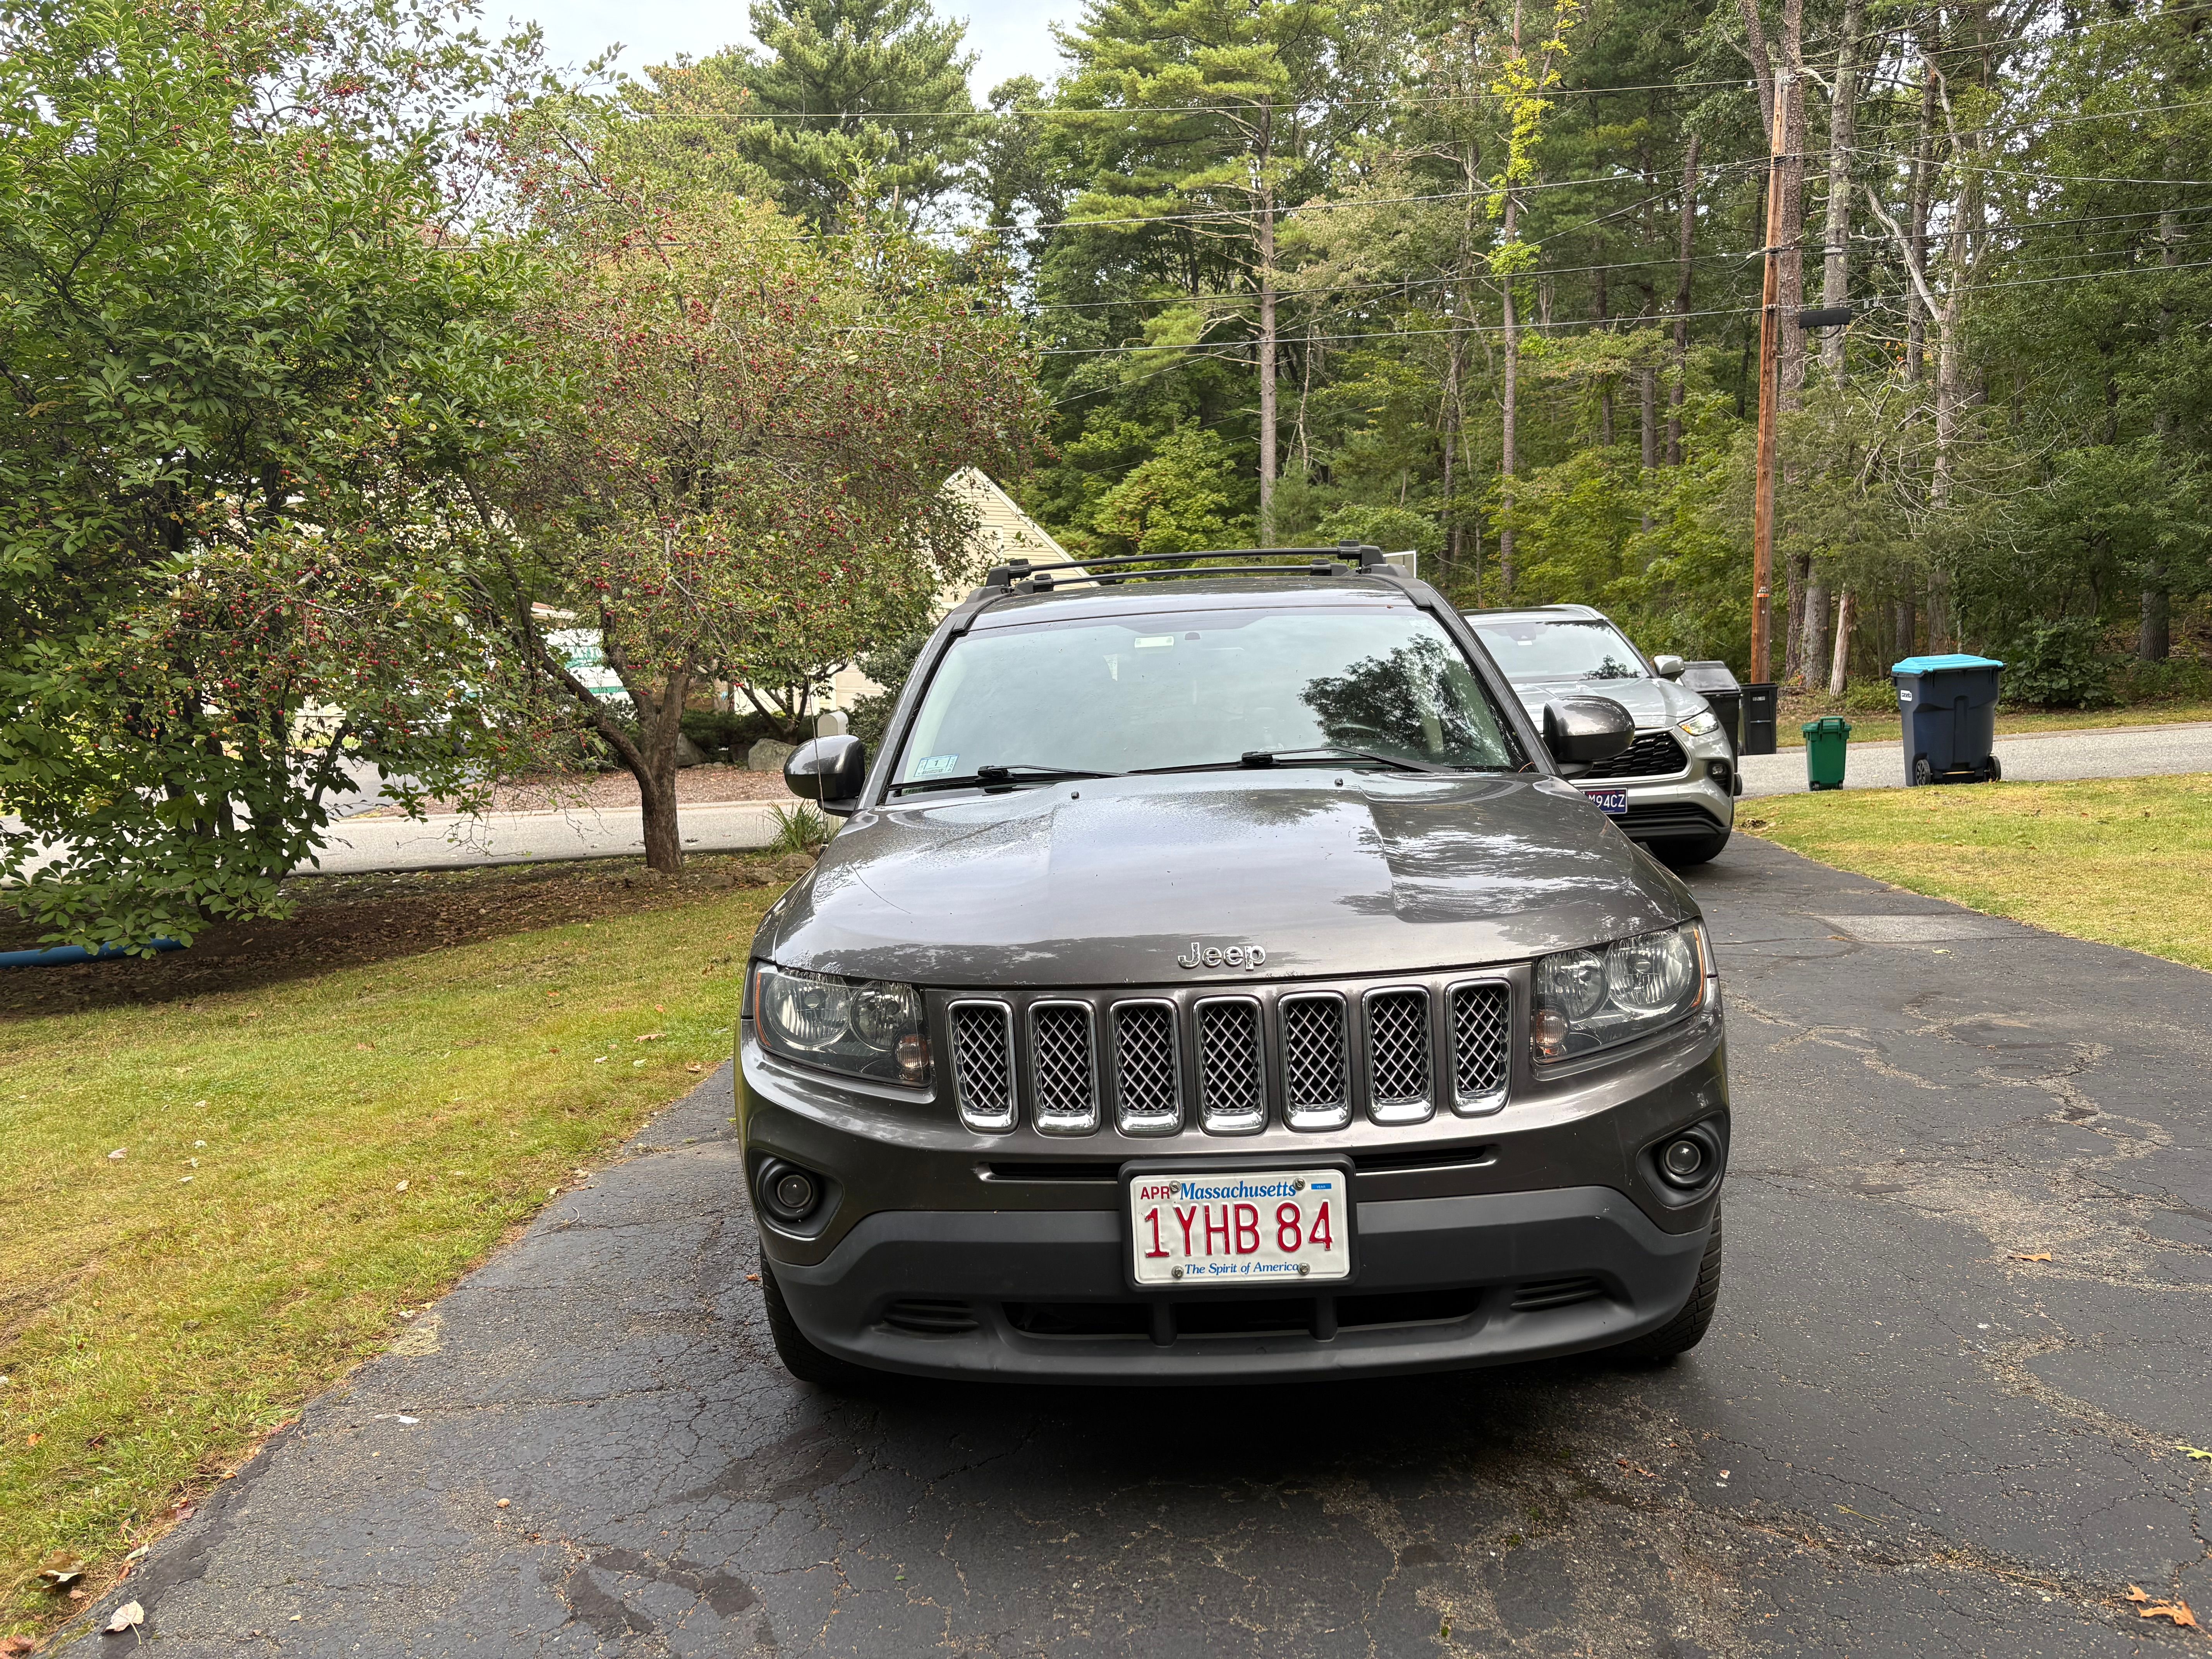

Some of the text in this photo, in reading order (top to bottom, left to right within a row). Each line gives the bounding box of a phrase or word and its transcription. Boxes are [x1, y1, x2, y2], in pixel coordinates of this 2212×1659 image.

[1178, 942, 1266, 971] Jeep
[1140, 1186, 1170, 1200] APR
[1180, 1180, 1297, 1200] Massachusetts
[1145, 1201, 1333, 1258] 1YHB 84
[1185, 1262, 1299, 1275] The Spirit of America
